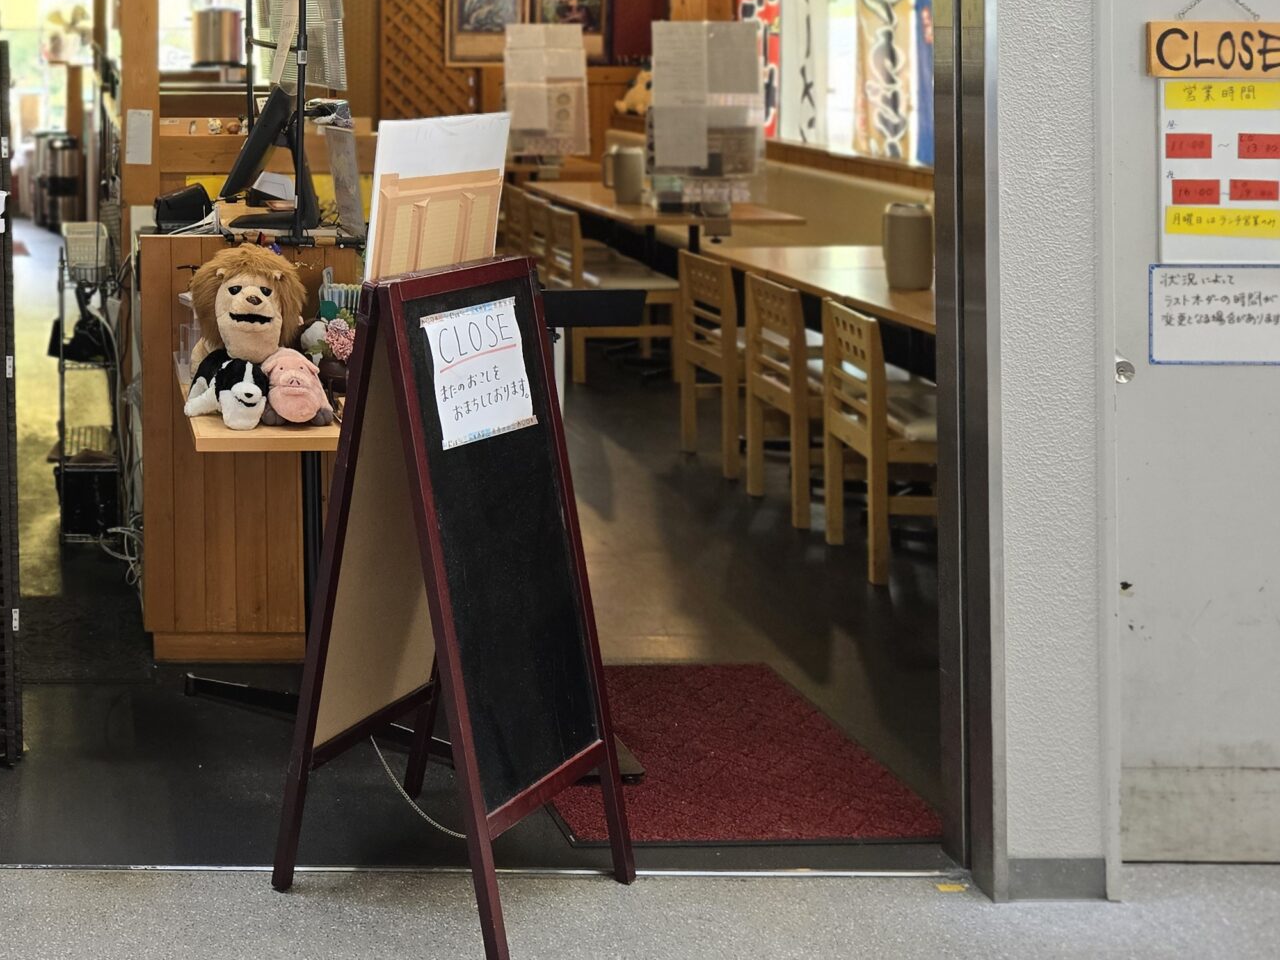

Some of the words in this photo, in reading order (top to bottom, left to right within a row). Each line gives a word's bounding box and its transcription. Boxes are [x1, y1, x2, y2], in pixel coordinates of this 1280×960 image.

[1183, 84, 1256, 102] 営業時間
[1160, 273, 1235, 287] 状況によって
[438, 313, 513, 364] CLOSE
[440, 365, 501, 403] またのおこしを
